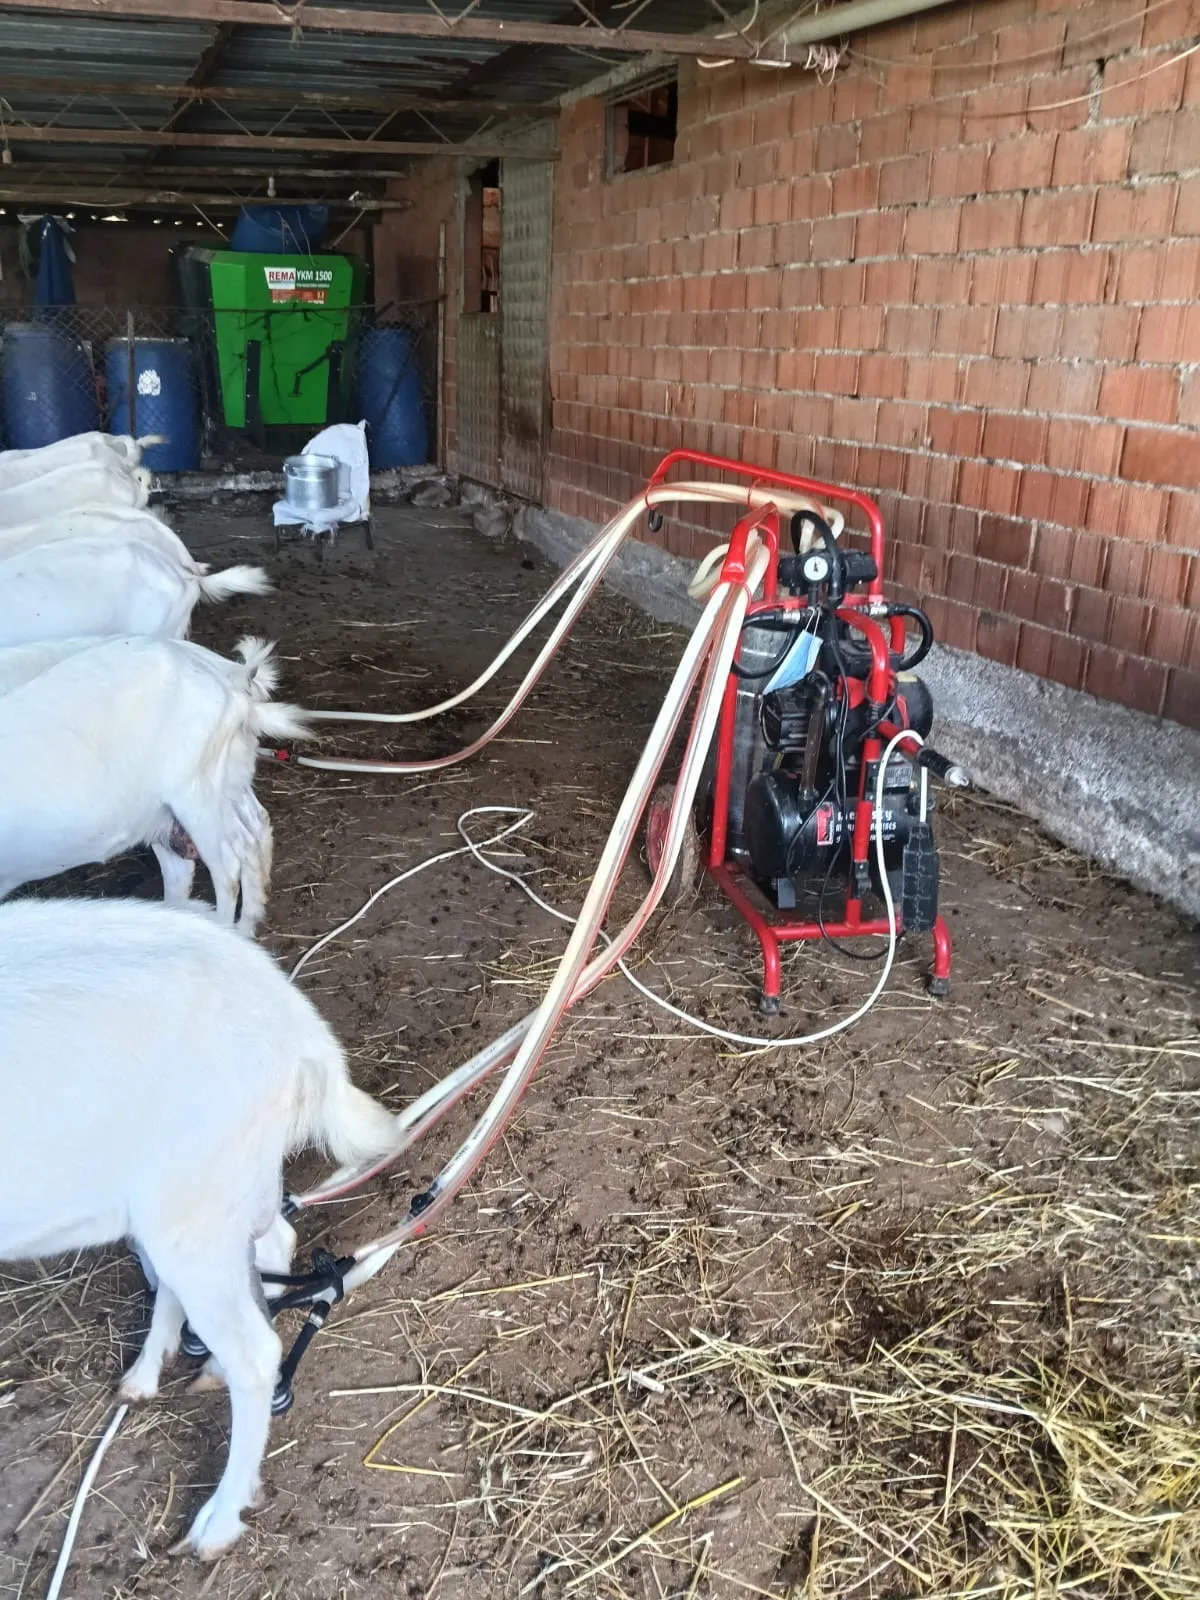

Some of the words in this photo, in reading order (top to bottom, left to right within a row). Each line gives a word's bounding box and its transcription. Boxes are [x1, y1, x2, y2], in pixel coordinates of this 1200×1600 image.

[269, 271, 295, 281] REMA
[296, 270, 313, 281] YKM
[315, 270, 333, 281] 1500
